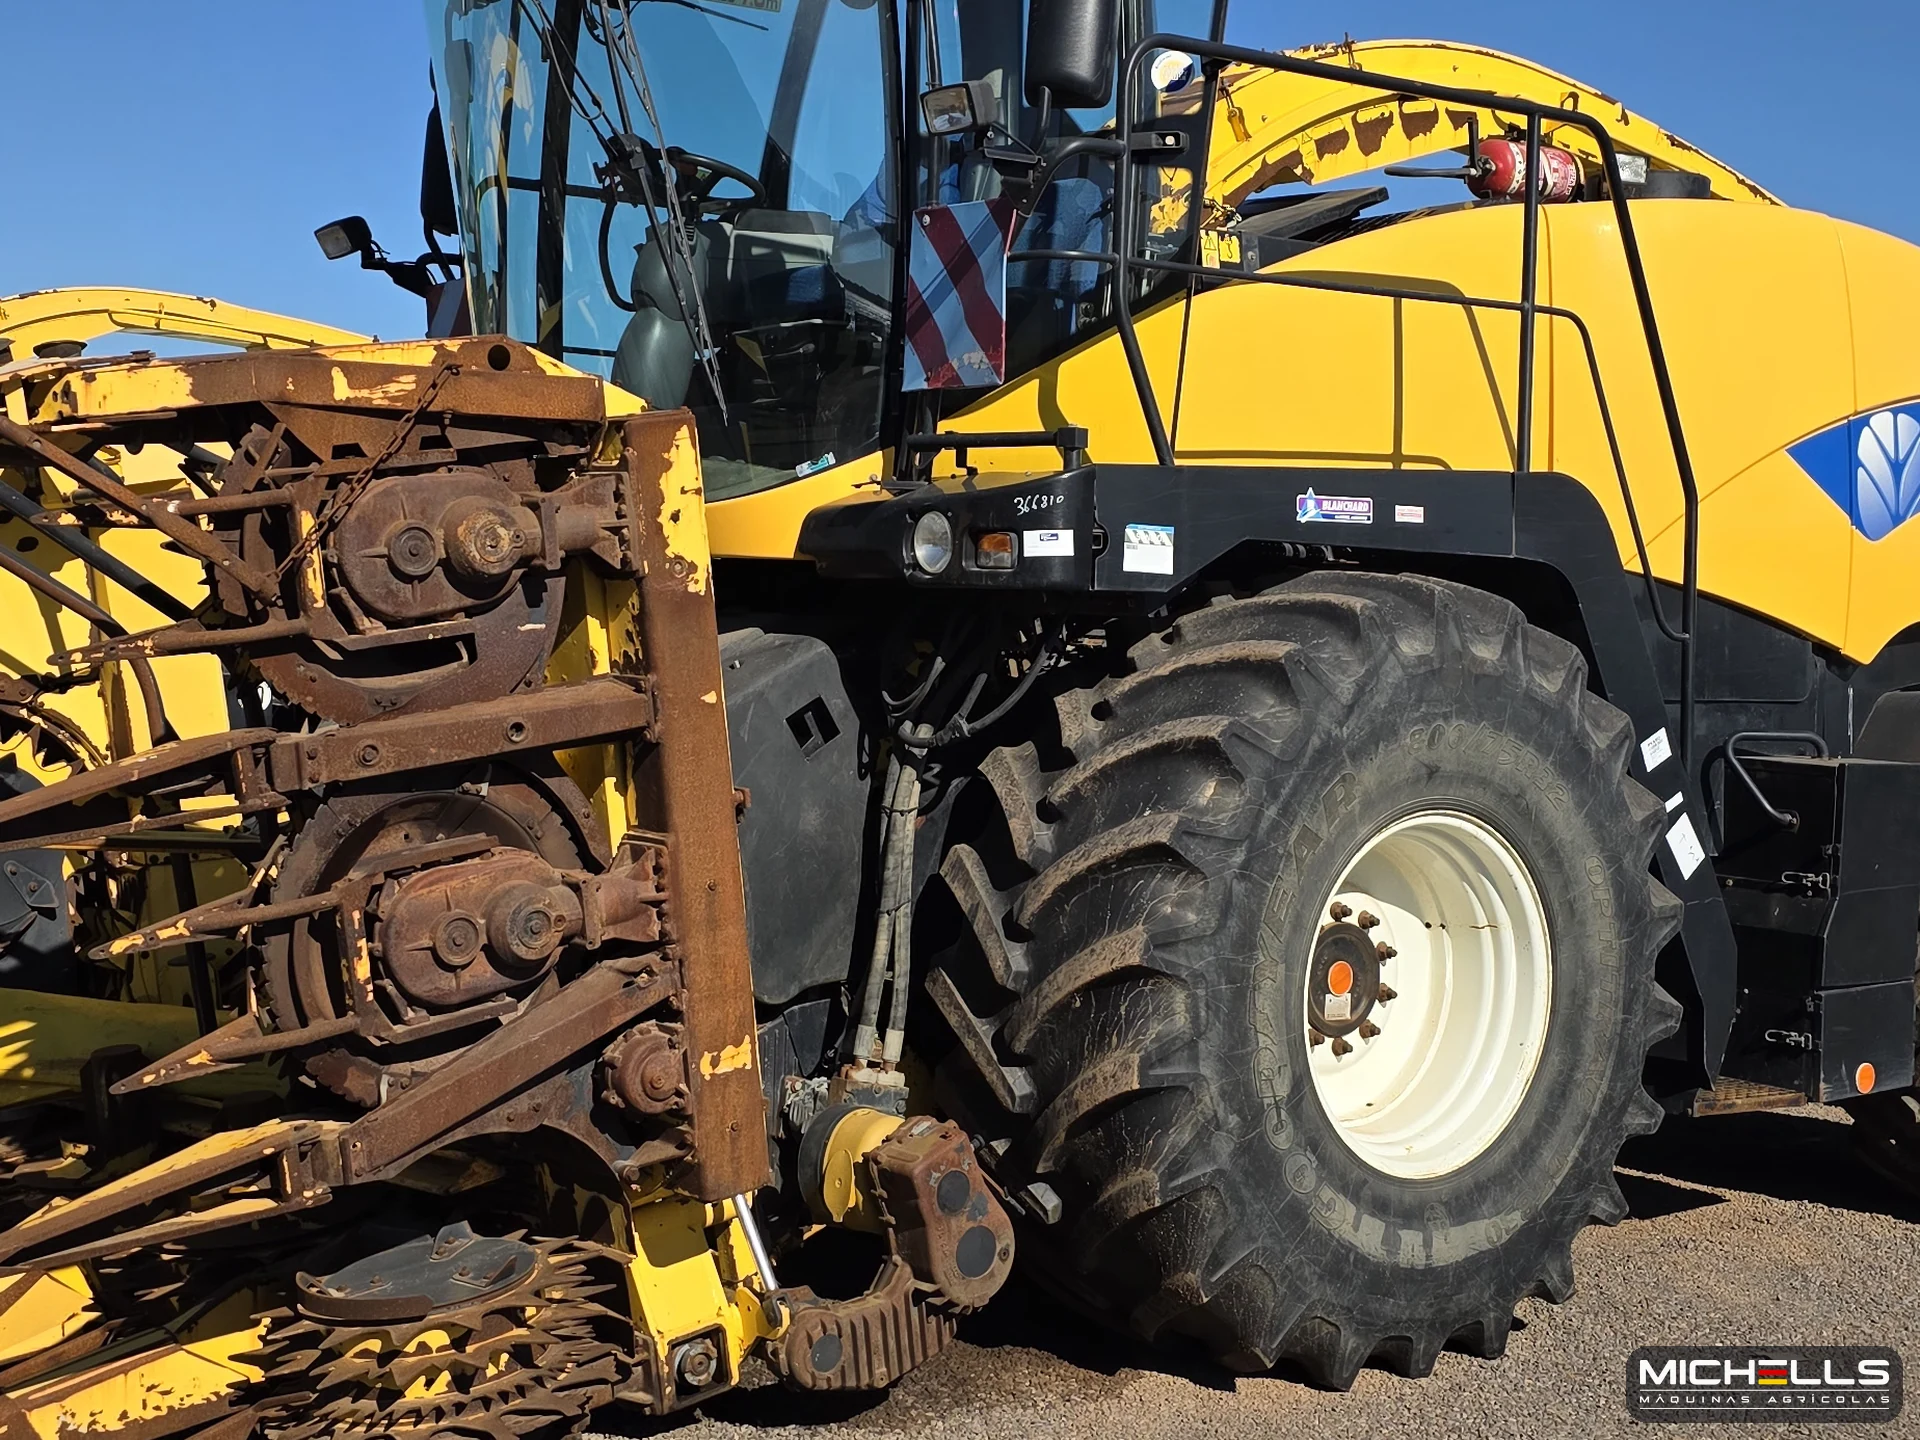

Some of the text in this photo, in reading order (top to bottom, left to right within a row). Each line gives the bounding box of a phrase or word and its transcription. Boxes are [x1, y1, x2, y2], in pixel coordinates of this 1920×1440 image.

[1014, 494, 1065, 516] 366810
[1321, 500, 1369, 512] BLANCHARD
[1248, 771, 1358, 1231] GOODYEAR
